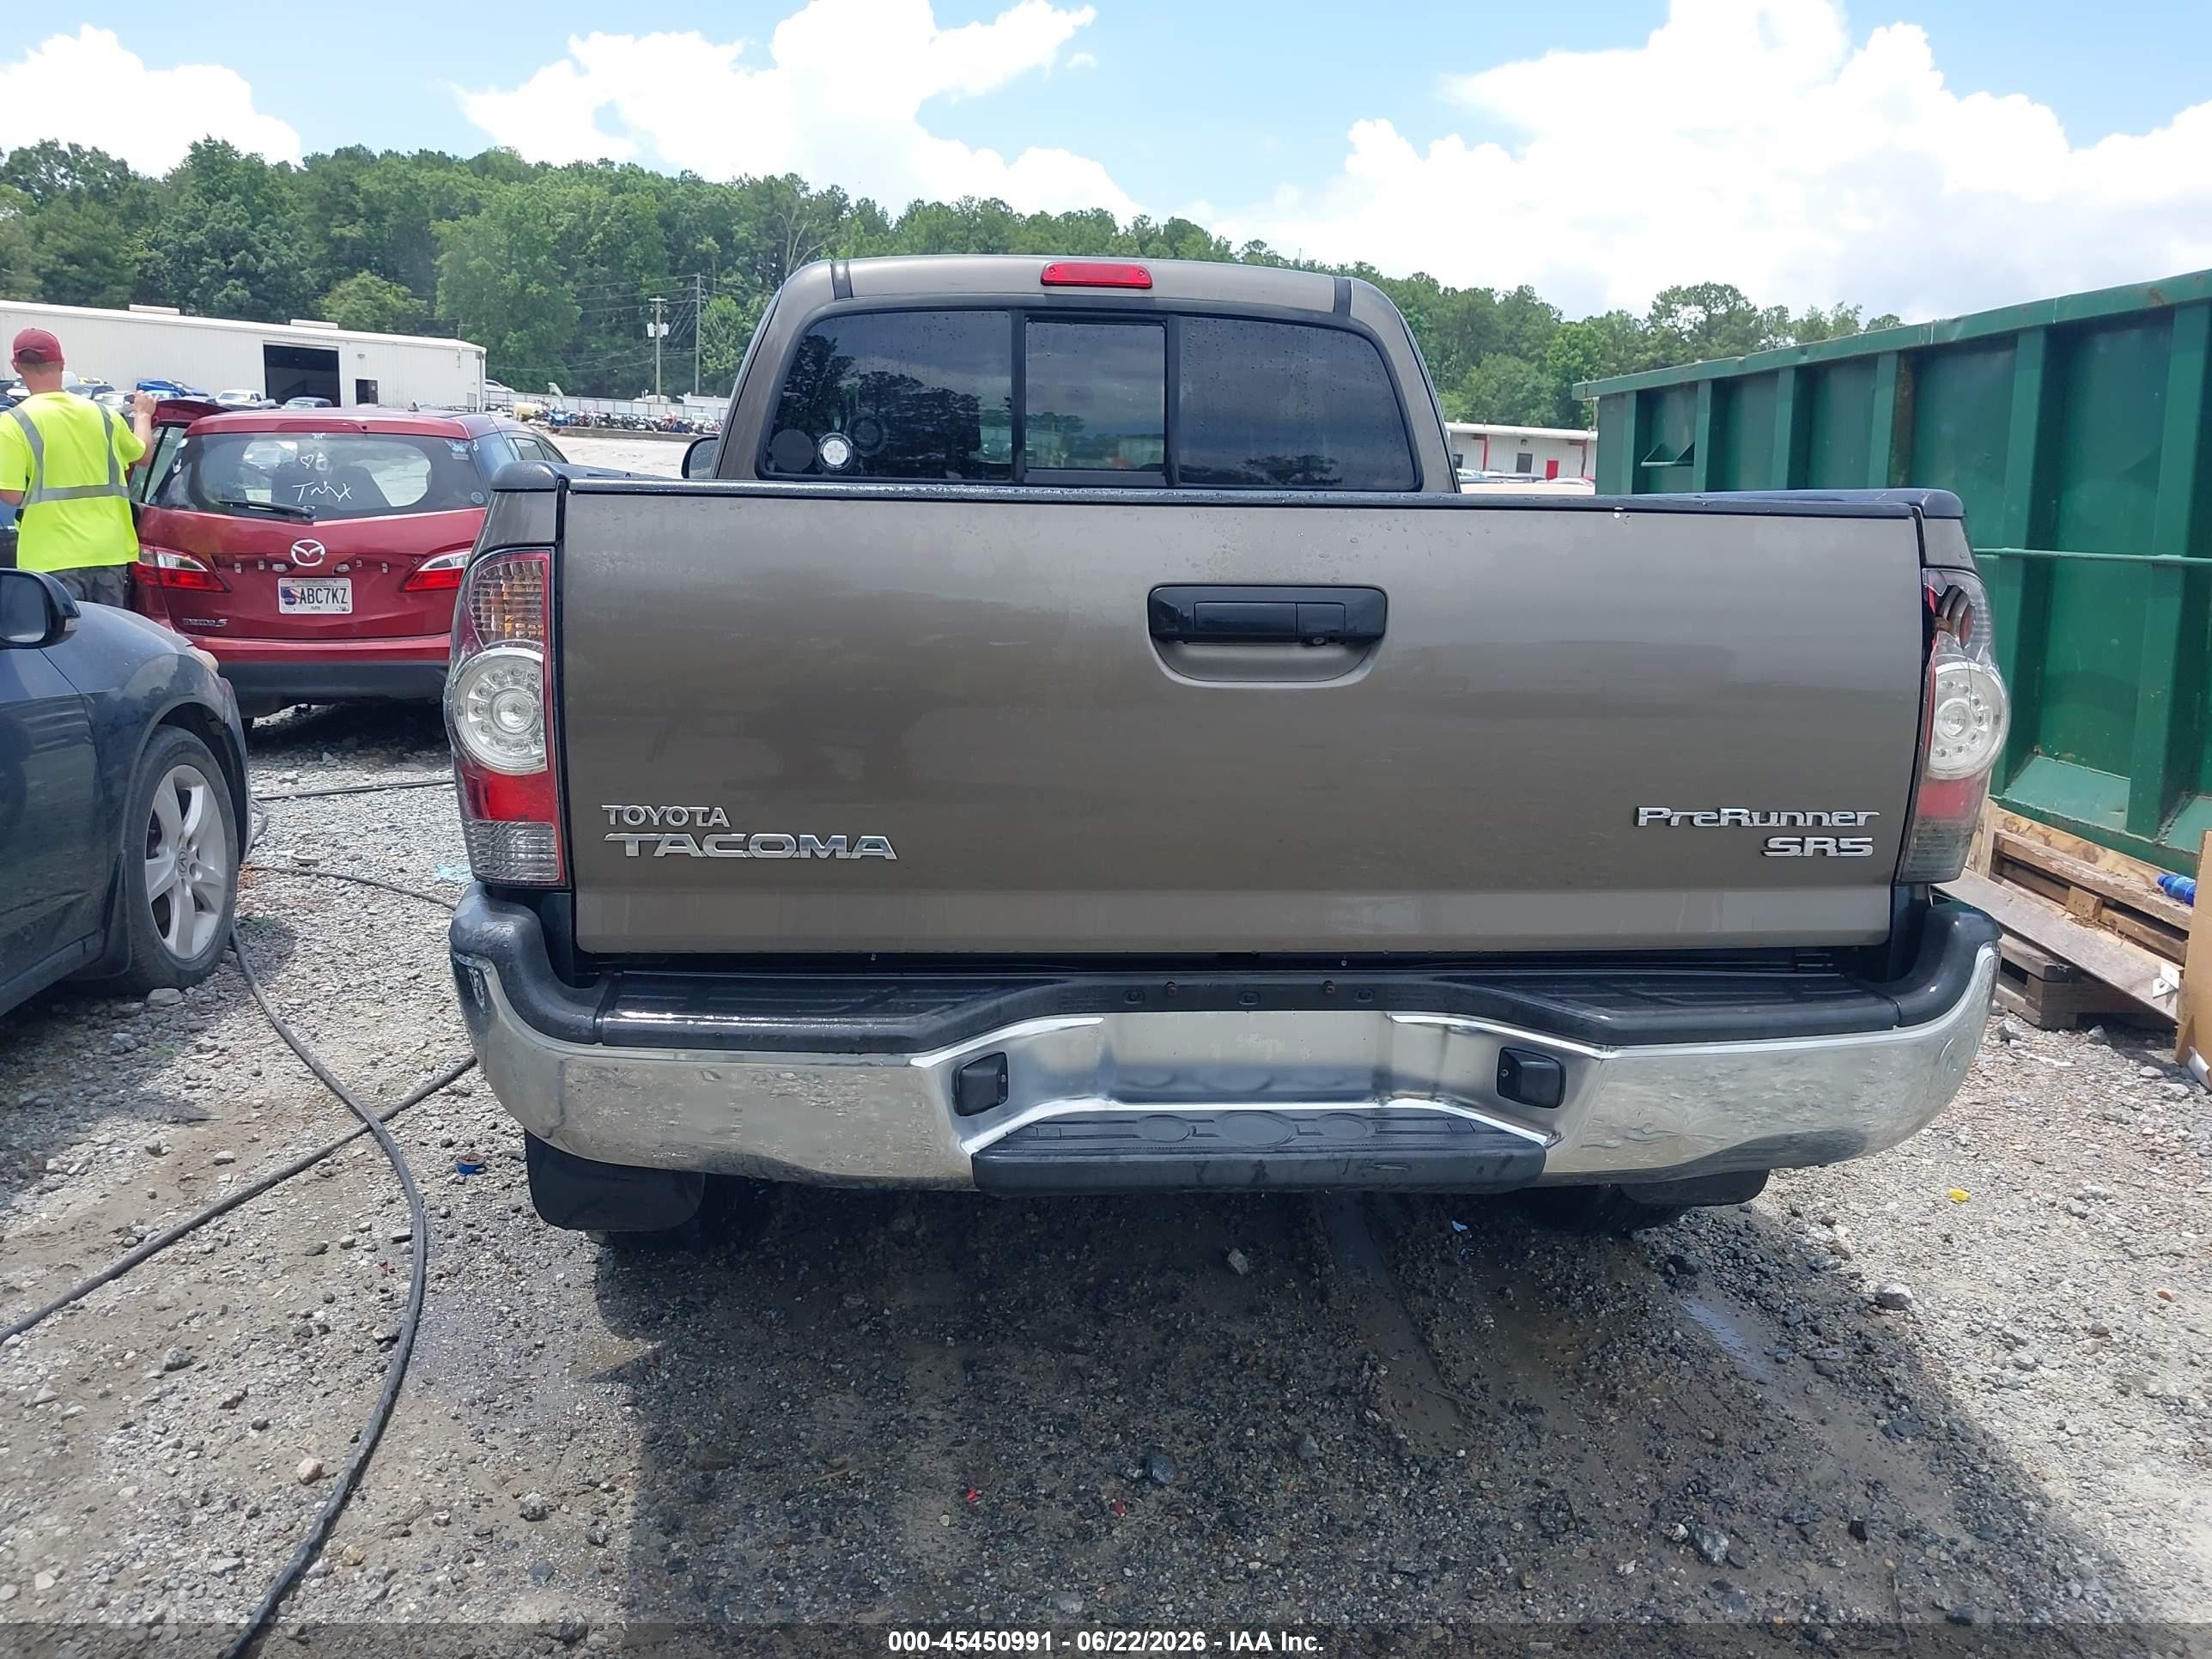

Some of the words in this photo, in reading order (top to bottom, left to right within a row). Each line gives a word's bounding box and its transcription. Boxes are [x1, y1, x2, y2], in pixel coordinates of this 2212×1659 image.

[300, 587, 348, 605] ABC7KZ
[601, 805, 731, 827] TOYOTA
[1637, 806, 1881, 827] PreRunner
[604, 833, 897, 860] TACOMA
[1762, 836, 1874, 858] SR5
